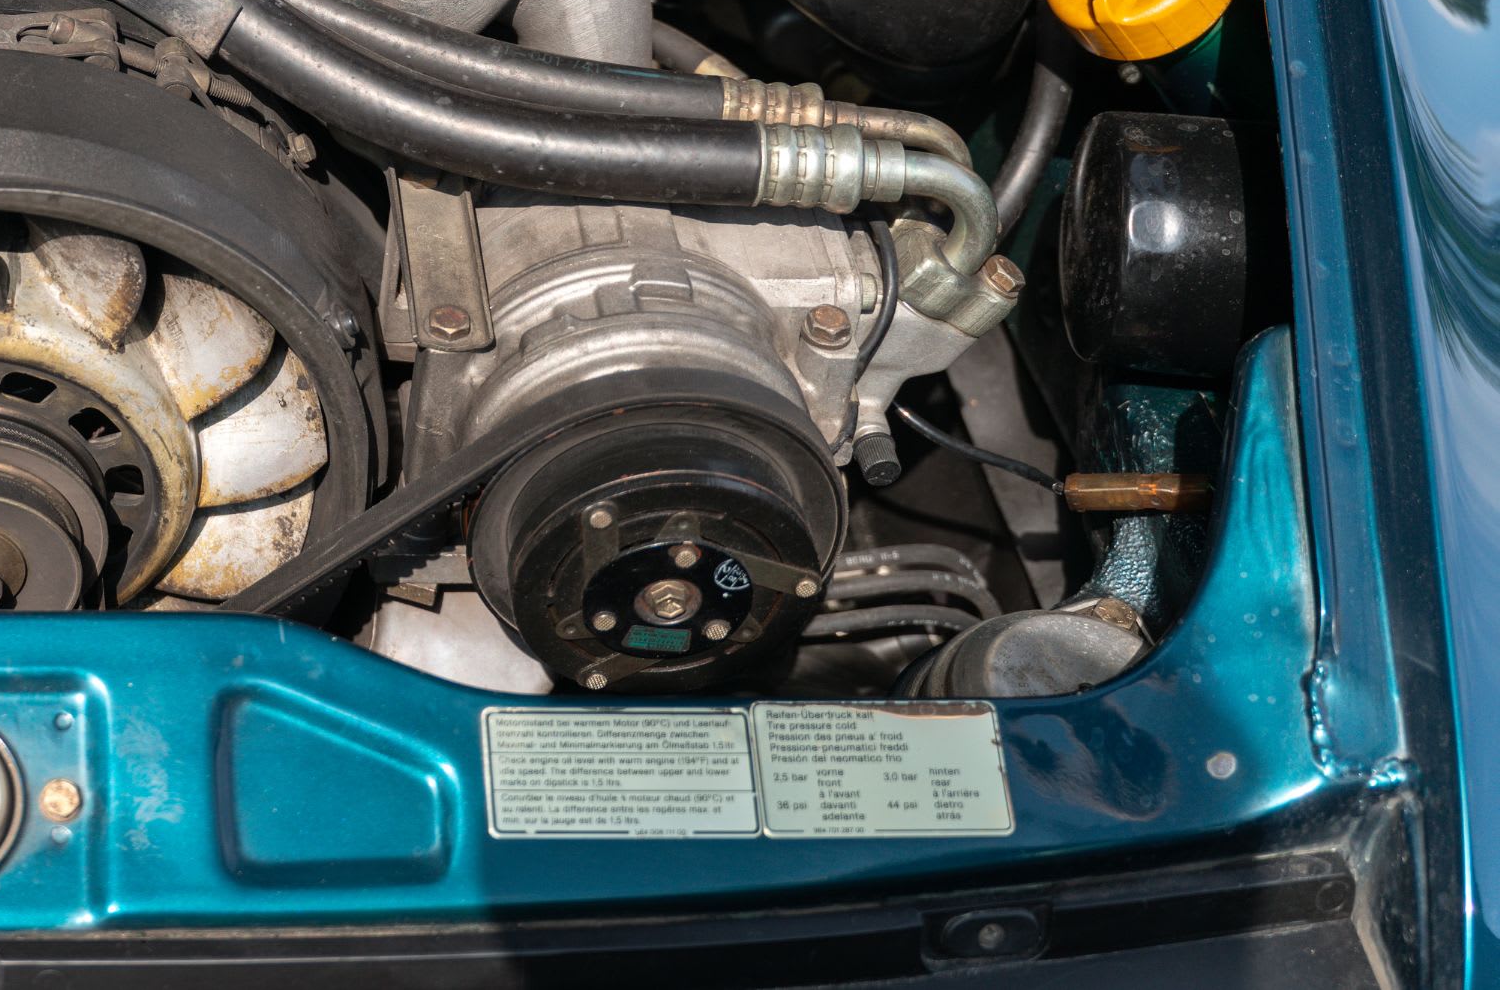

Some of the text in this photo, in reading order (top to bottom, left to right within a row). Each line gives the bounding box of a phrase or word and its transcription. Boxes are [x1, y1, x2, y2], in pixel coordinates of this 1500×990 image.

[855, 709, 873, 718] kalt
[573, 718, 610, 727] warmem
[612, 718, 638, 727] Motor
[672, 718, 689, 727] und
[767, 720, 856, 730] Tire pressure cold
[768, 731, 810, 742] Pression
[813, 731, 831, 741] des
[834, 731, 865, 741] pneus
[879, 731, 903, 741] froid
[539, 740, 556, 749] und
[644, 740, 658, 749] am
[769, 742, 908, 752] Pressione pneumatici freddi
[529, 756, 559, 765] engine
[561, 756, 571, 765] oil
[597, 756, 615, 765] with
[618, 756, 642, 765] warm
[645, 756, 674, 765] engine
[711, 756, 727, 765] and
[730, 756, 739, 765] at
[811, 753, 826, 762] del
[885, 753, 902, 762] frio
[550, 767, 566, 776] The
[569, 767, 613, 776] difference
[616, 767, 654, 776] between
[657, 767, 682, 776] upper
[685, 767, 702, 776] and
[705, 767, 729, 776] lower
[928, 767, 959, 775] hinten
[772, 772, 808, 782] 2,5 bar
[901, 772, 917, 780] bar
[545, 793, 553, 802] le
[663, 793, 690, 802] chaud
[828, 789, 860, 797] l'avant
[792, 800, 807, 810] psi
[819, 801, 855, 809] davanti
[887, 800, 917, 810] 44 psi
[933, 800, 963, 808] dietro
[821, 812, 865, 820] adelante
